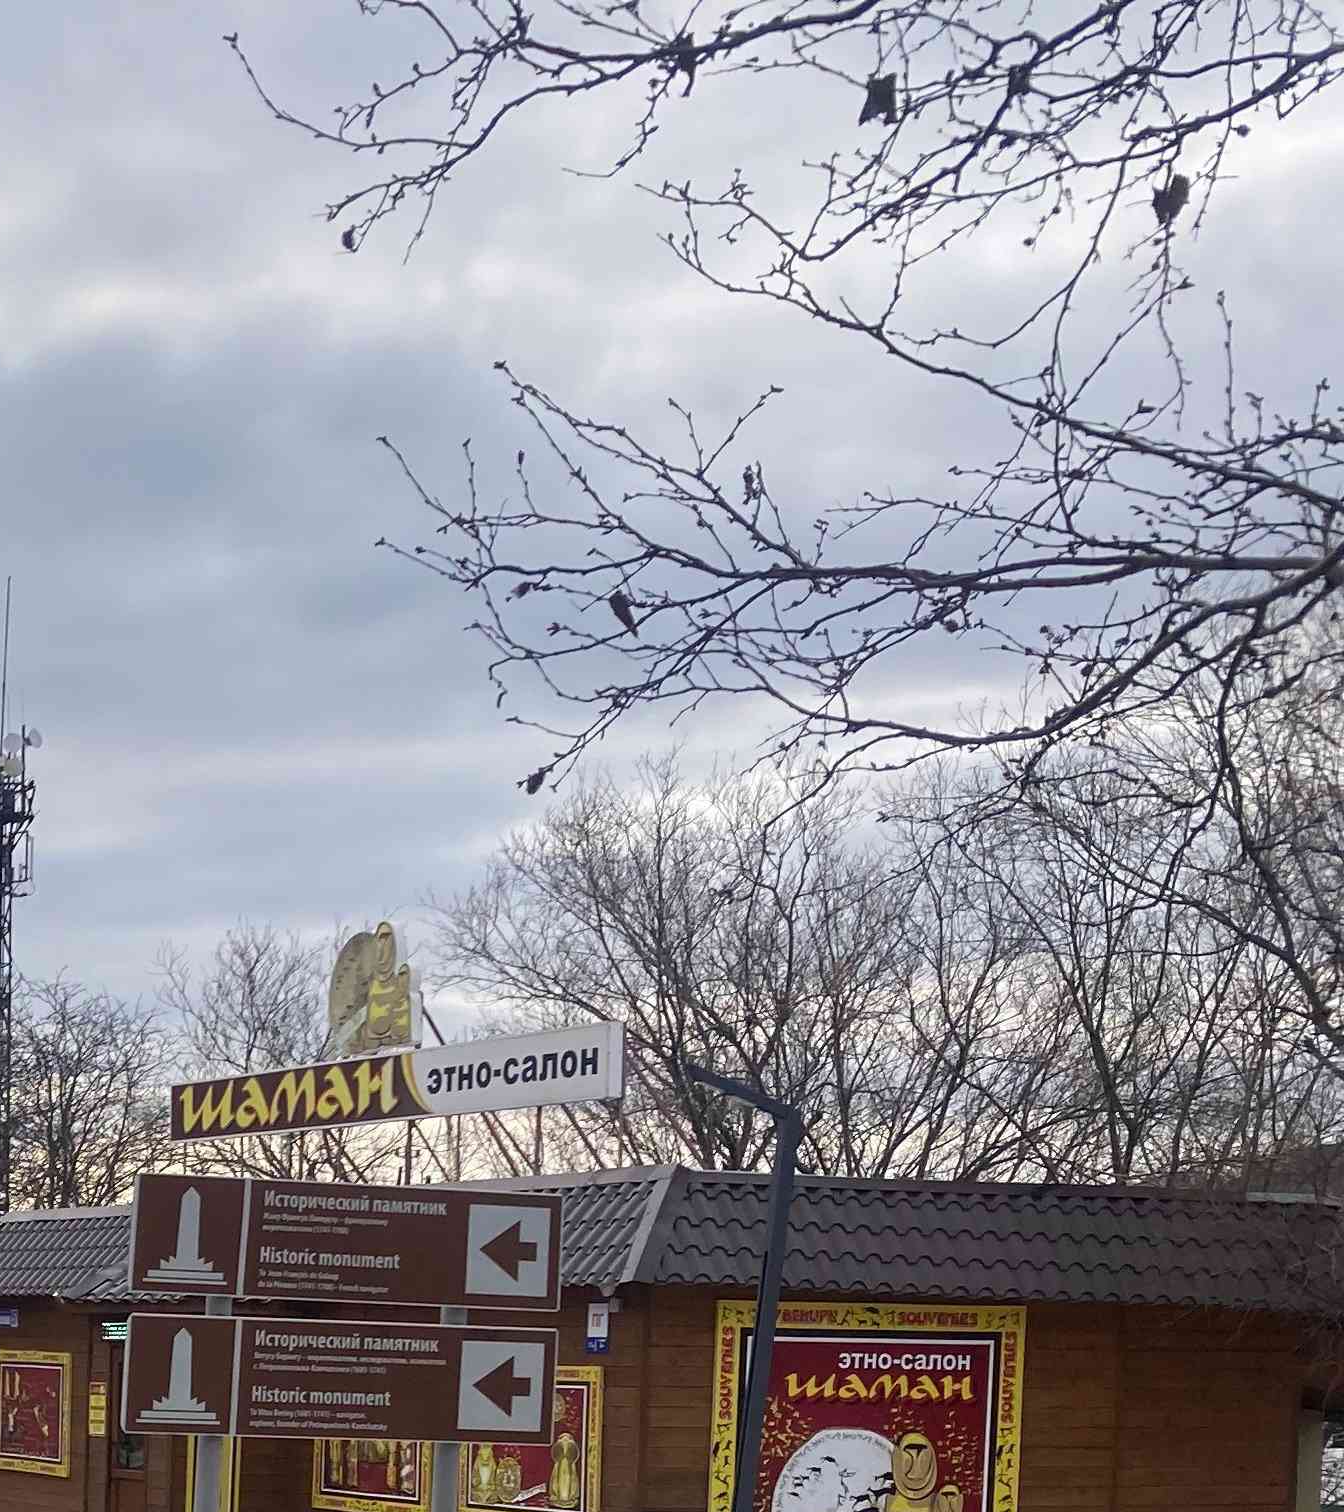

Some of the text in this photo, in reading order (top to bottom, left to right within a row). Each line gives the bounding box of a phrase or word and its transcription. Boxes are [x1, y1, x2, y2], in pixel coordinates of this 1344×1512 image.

[264, 1189, 448, 1216] Исторический памятник
[259, 1246, 400, 1269] Historic monument
[255, 1328, 439, 1353] Исторический памятник
[252, 1385, 391, 1407] Historic monument
